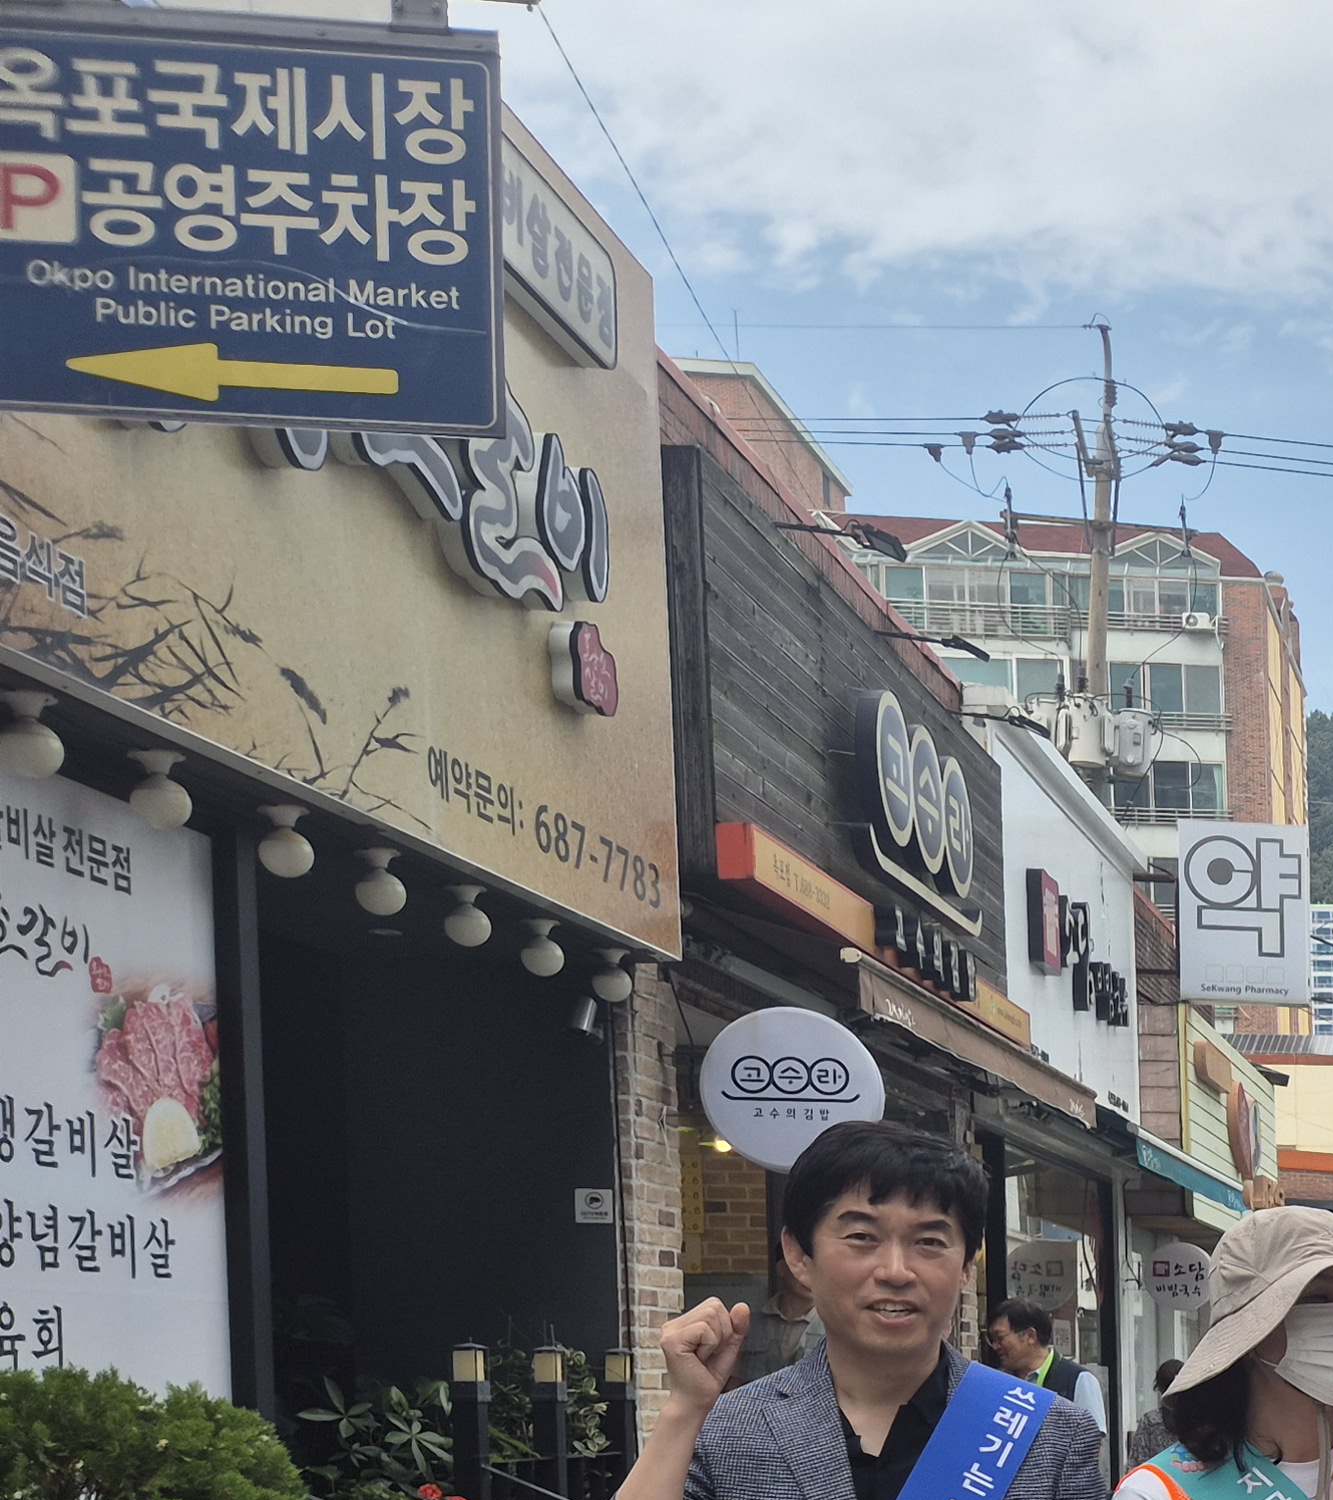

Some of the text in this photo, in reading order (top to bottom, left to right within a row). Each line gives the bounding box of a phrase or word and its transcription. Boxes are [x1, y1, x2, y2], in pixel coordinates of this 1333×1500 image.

[0, 47, 474, 165] 옥포국제시장
[1, 163, 61, 230] P
[82, 157, 477, 266] 공영주차장
[26, 260, 460, 310] Okpo International Market
[96, 297, 396, 339] Public Parking Lot
[0, 804, 132, 896] 비살 전문점
[428, 745, 661, 909] 예약문의: 687-7783
[1184, 835, 1302, 958] 약
[1201, 983, 1290, 997] SeKwang Pharmacy
[804, 1108, 830, 1121] 김밥
[0, 1198, 176, 1280] 양념갈비살
[1174, 1261, 1205, 1282] 소담
[1156, 1284, 1202, 1298] 비빔국수
[962, 1386, 1037, 1497] 쓰레기는
